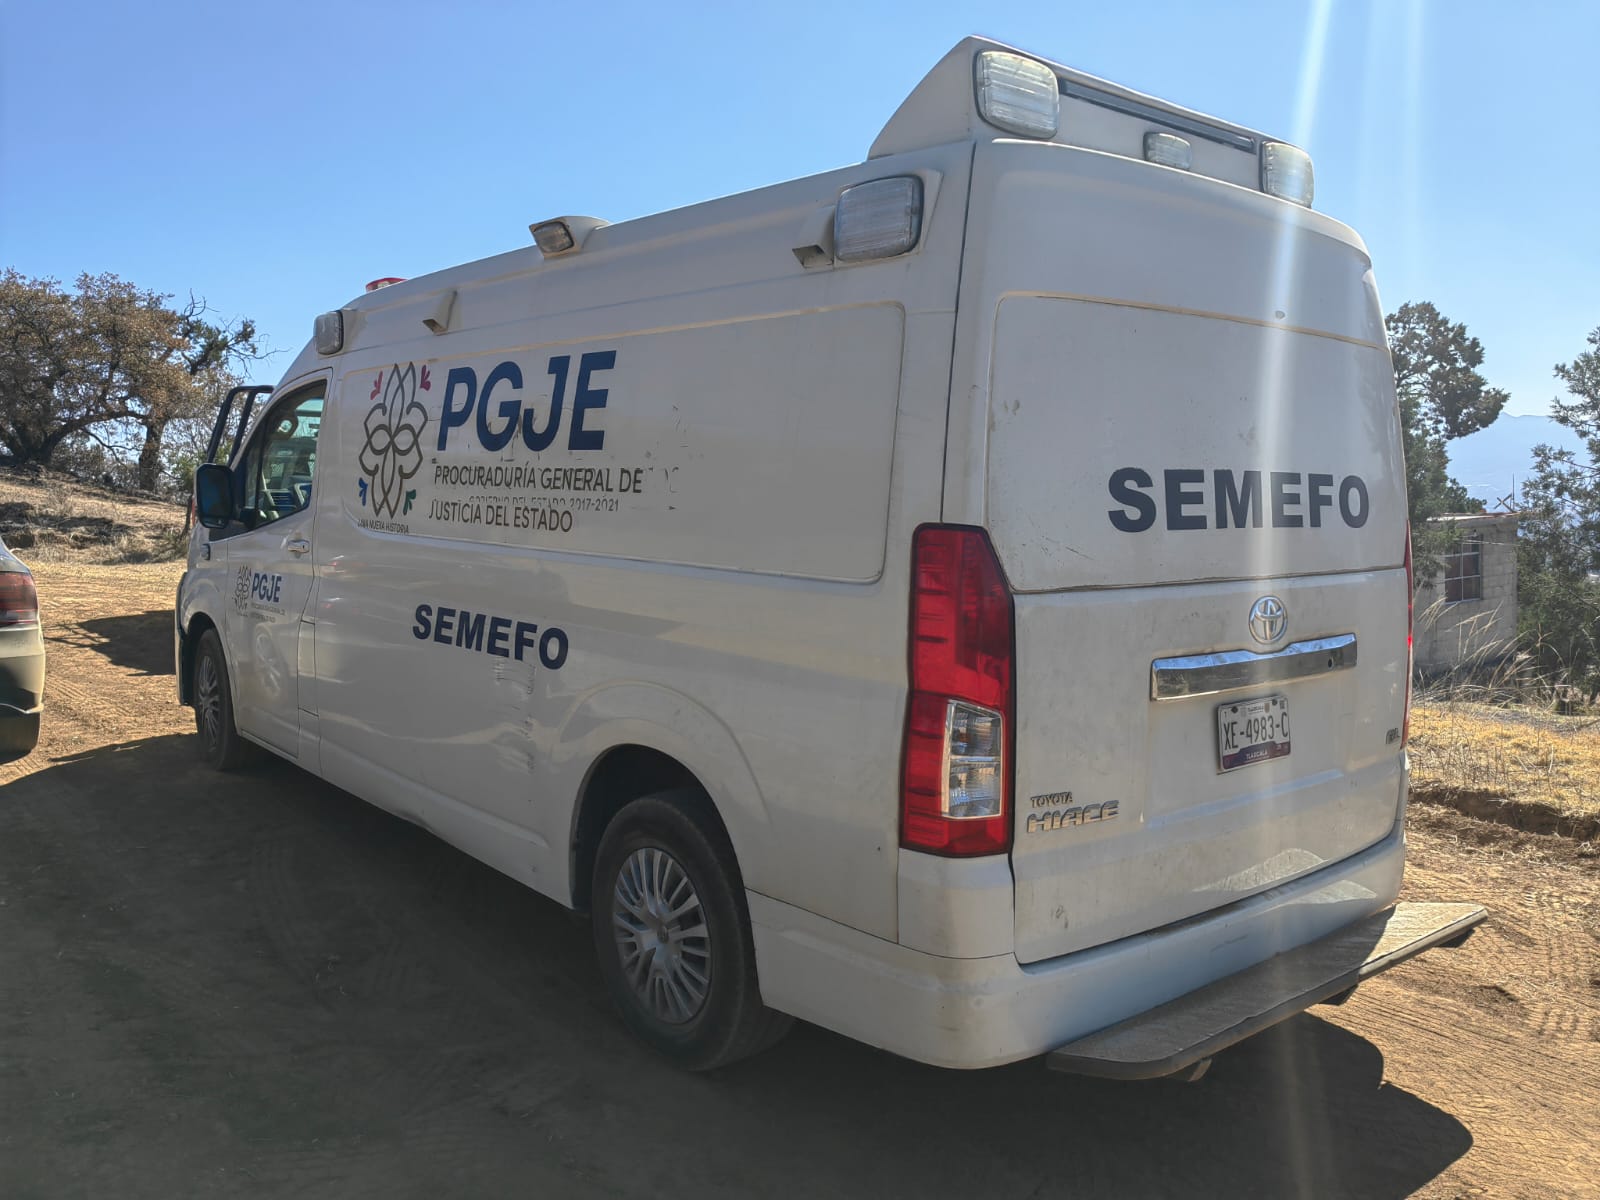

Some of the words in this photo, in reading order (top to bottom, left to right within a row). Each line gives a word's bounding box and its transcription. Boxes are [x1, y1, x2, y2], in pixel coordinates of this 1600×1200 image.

[437, 350, 617, 452] PGJE
[434, 461, 536, 489] PROCURADURÍA
[541, 467, 613, 492] GENERAL
[619, 467, 643, 493] DE
[428, 498, 482, 524] JUSTICIA
[485, 504, 510, 527] DEL
[513, 505, 573, 533] ESTADO
[1108, 466, 1370, 533] SEMEFO
[251, 572, 282, 603] PGJE
[412, 603, 569, 670] SEMEFO
[1223, 711, 1289, 751] XE-4983-C
[1027, 799, 1120, 833] HIACE
[1030, 791, 1073, 808] TOYOTA
